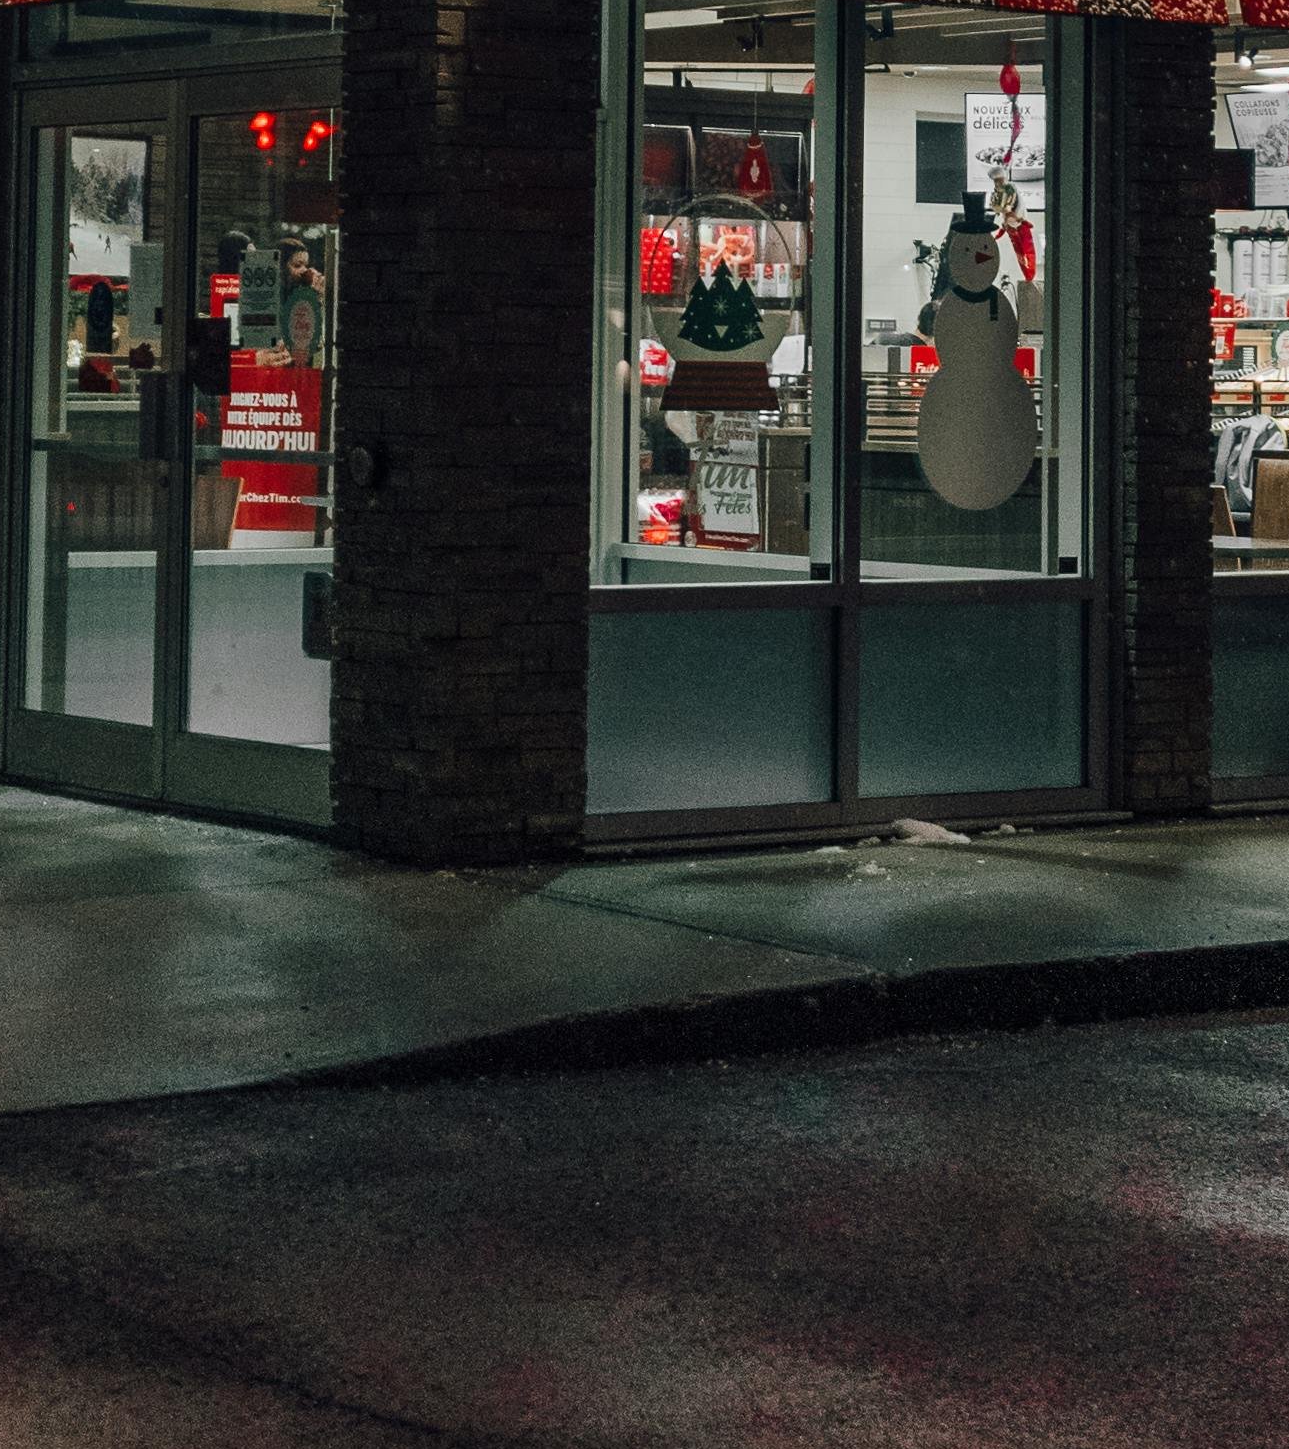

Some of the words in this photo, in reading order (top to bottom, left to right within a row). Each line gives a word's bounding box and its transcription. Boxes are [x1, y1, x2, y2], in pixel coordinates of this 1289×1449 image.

[1234, 99, 1280, 109] COLLATIONS
[1235, 107, 1278, 117] COPIEUSES
[282, 409, 303, 427] DÈS
